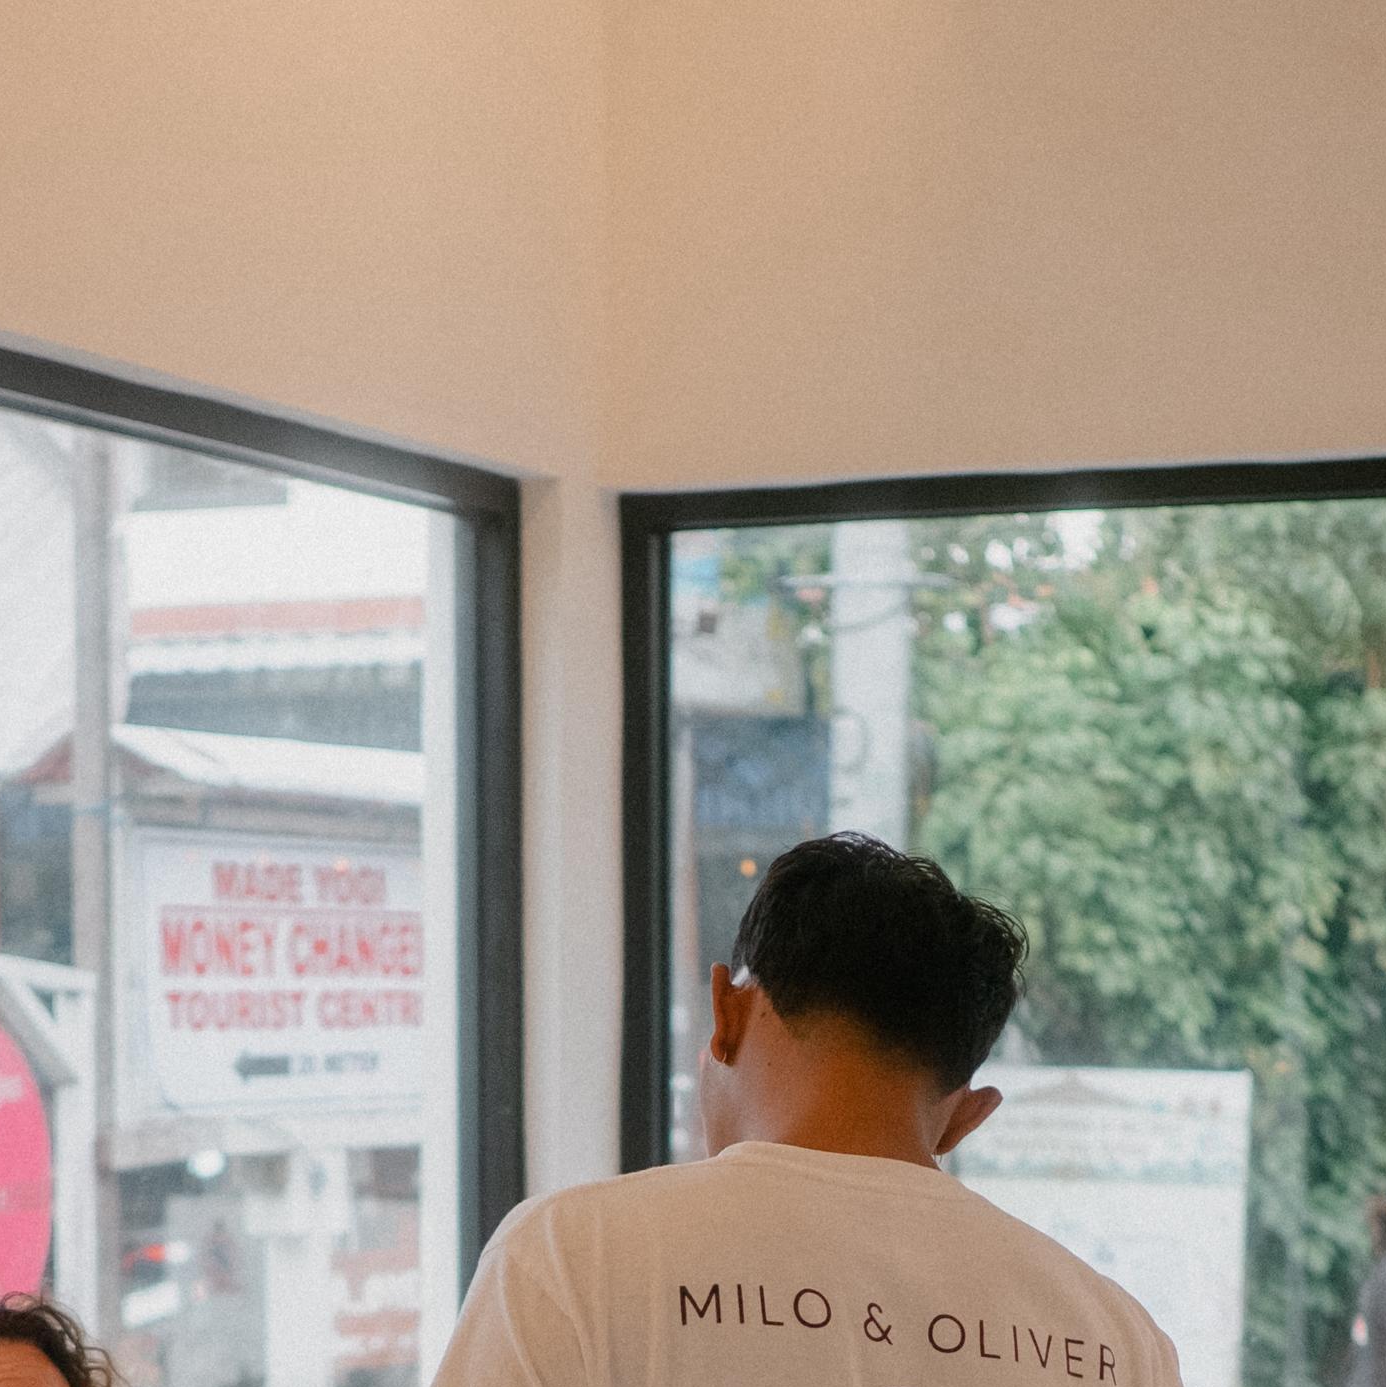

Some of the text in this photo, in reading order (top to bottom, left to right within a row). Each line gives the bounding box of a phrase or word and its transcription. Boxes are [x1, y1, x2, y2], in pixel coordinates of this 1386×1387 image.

[161, 918, 274, 976] MONEY
[165, 990, 305, 1031] TOURIST
[679, 1284, 1117, 1386] MILO & OLIVER
